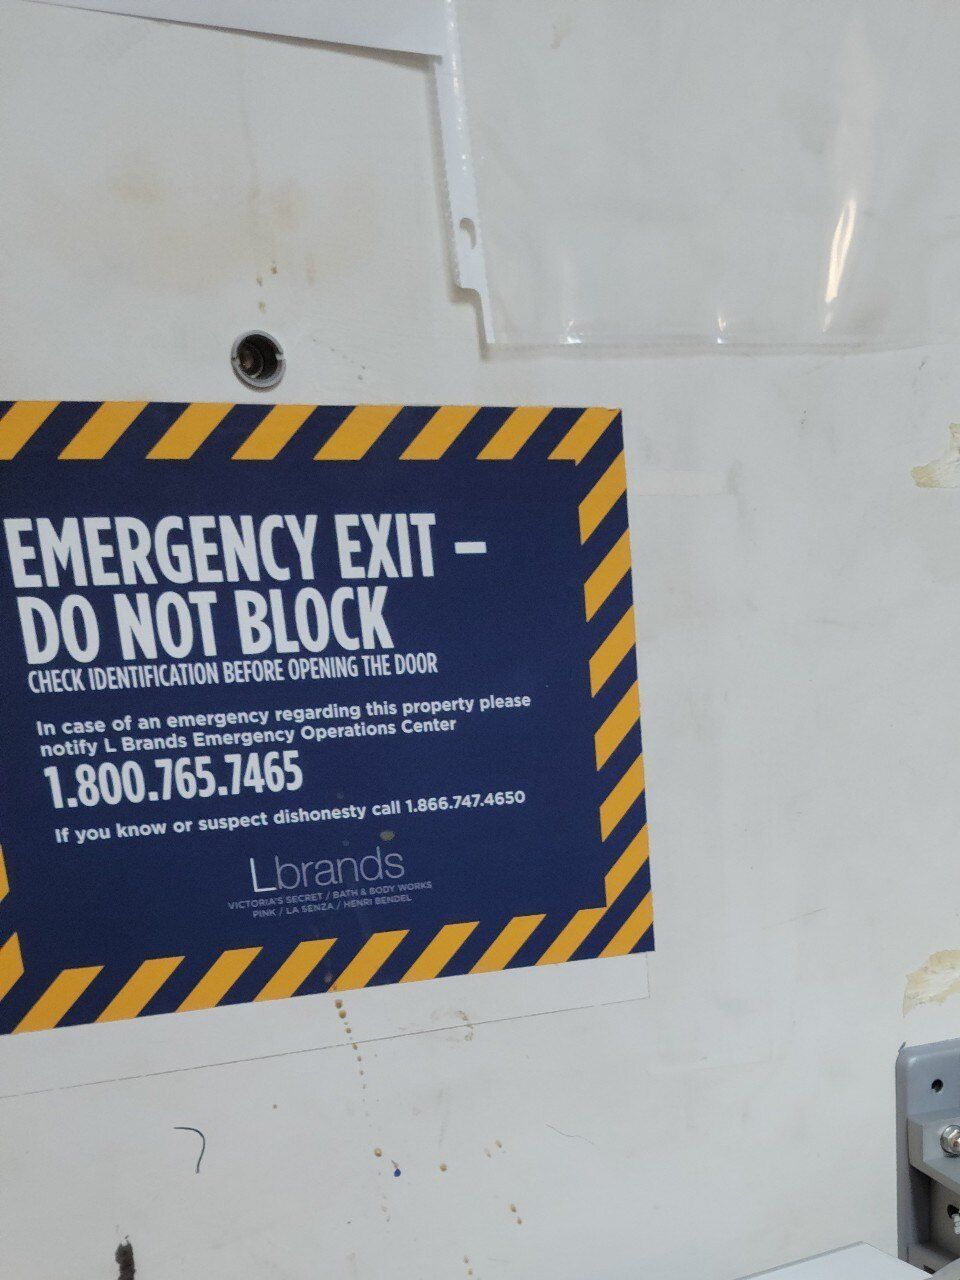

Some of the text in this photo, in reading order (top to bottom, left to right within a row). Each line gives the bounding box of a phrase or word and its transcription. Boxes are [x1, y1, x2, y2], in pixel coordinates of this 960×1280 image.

[3, 513, 318, 588] EMERGENCY
[334, 512, 436, 579] EXIT
[16, 586, 394, 664] DO NOT BLOCK
[28, 652, 439, 693] CHECK IDENTIFICATION BEFORE OPENING THE DOOR
[36, 694, 532, 736] In case of an emergency regarding this property please
[40, 717, 457, 757] notify L Brands Emergency Operations Center
[43, 749, 304, 809] 1.800.765.7465
[55, 790, 527, 845] If you know or suspect dishonesty call 1.866.747.4650
[227, 896, 283, 910] VICTORIA'S
[285, 892, 323, 904] SECRET
[332, 888, 358, 899] BATH
[360, 888, 367, 896] &
[369, 884, 396, 896] BODY
[397, 881, 433, 892] WORKS
[252, 908, 276, 919] PINK
[286, 905, 299, 915] LA
[301, 902, 333, 913] SENZA
[343, 897, 373, 909] HENRI
[374, 894, 413, 906] BENDEL
